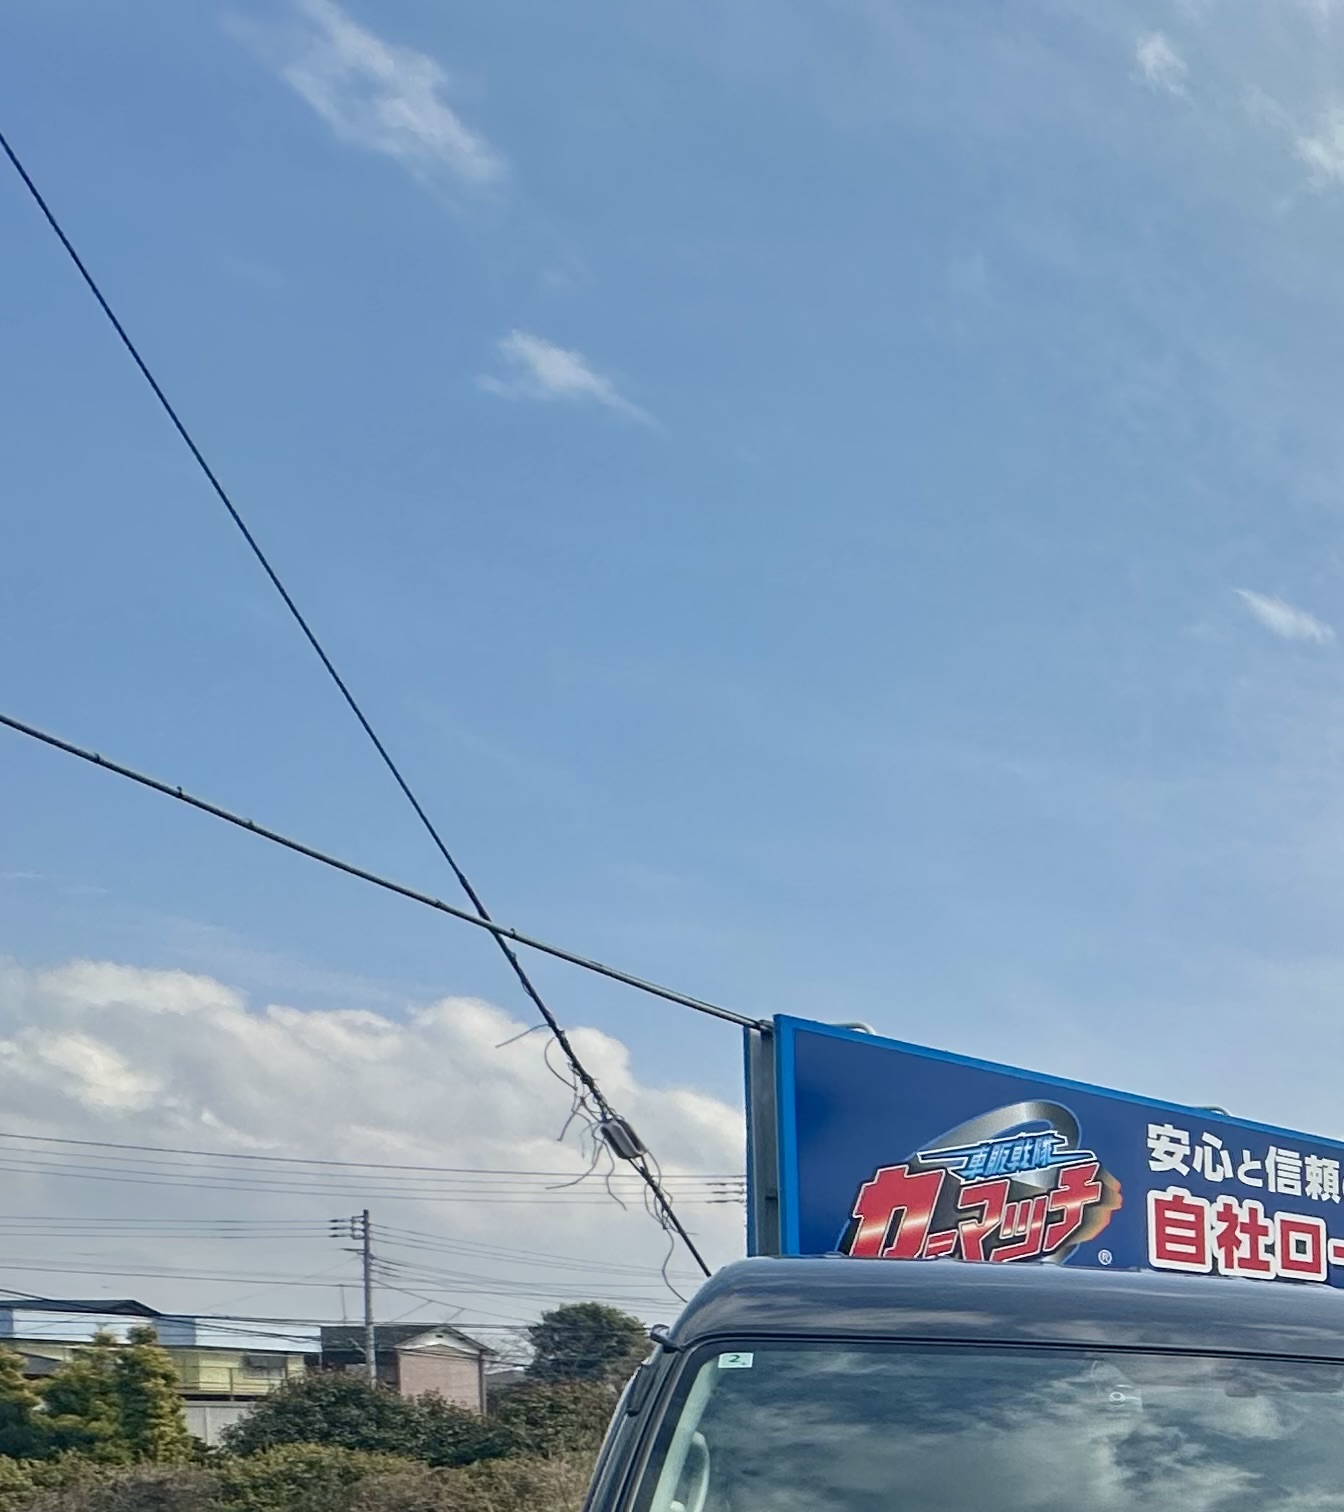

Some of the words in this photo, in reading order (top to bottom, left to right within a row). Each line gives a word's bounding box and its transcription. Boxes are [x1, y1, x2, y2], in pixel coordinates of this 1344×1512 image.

[849, 1161, 1102, 1263] カーマッチ
